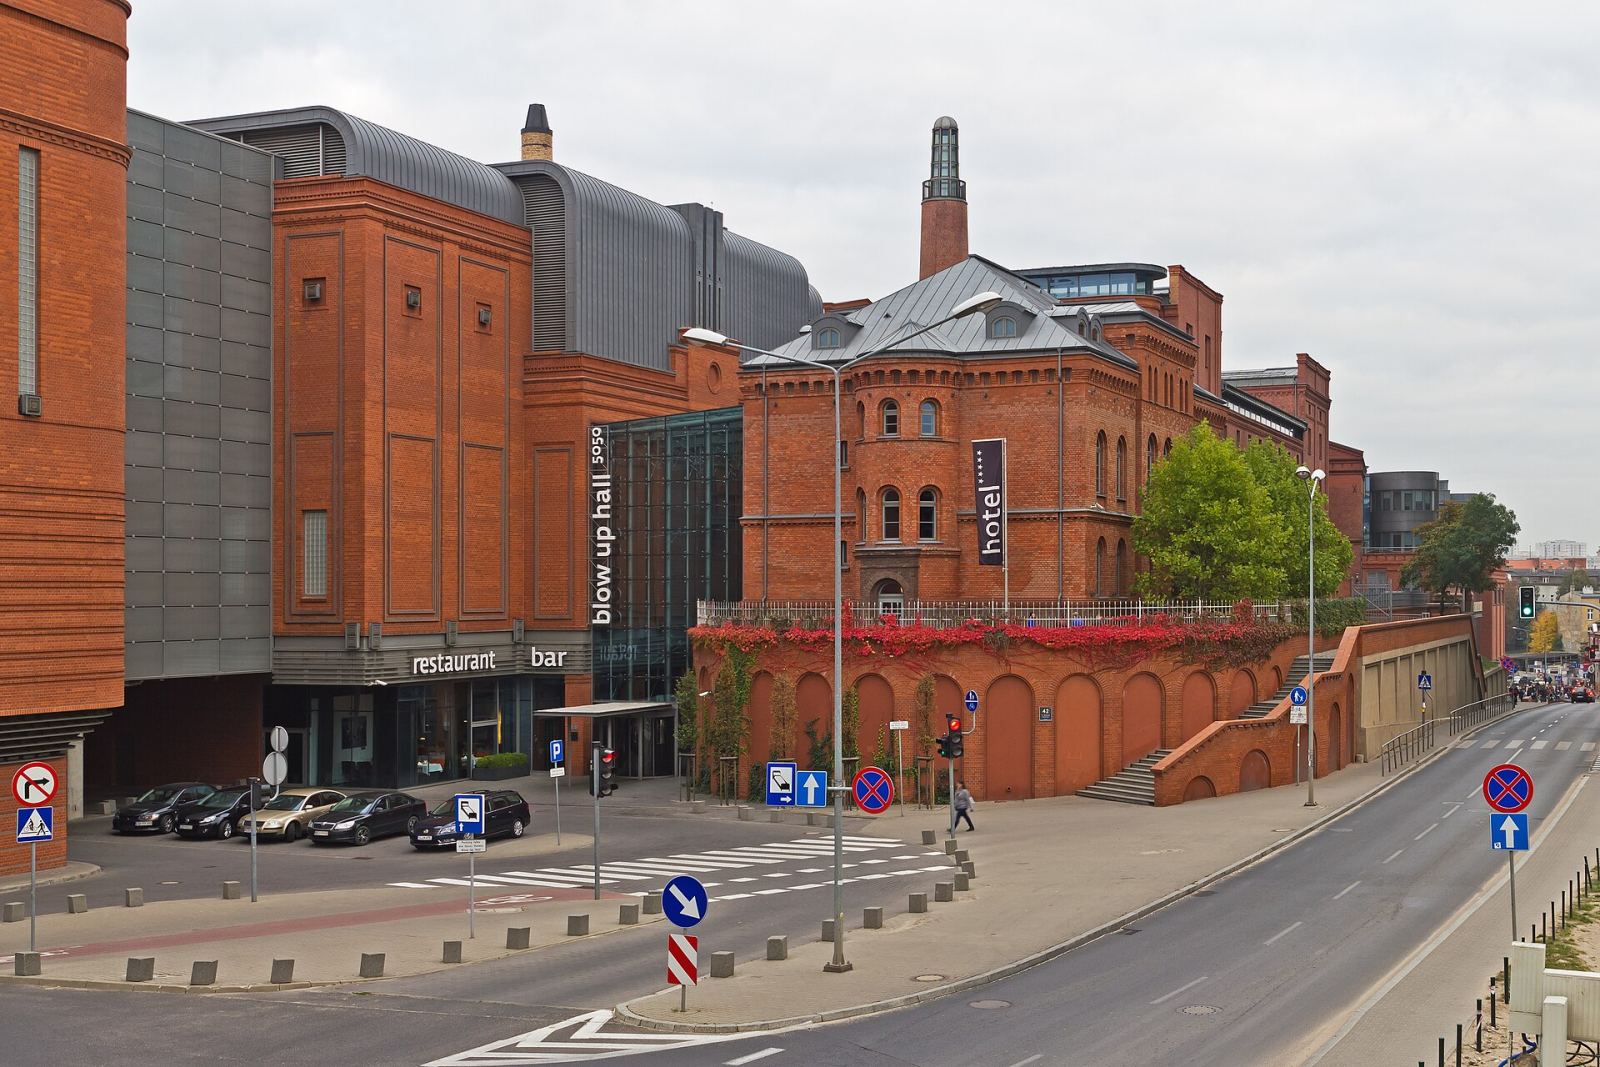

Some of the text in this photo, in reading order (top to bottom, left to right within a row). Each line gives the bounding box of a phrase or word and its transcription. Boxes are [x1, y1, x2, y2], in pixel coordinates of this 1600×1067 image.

[592, 427, 616, 624] blow up hall 5050
[978, 485, 1001, 554] hotel
[413, 650, 496, 674] restaurant
[531, 646, 567, 667] bar
[553, 743, 561, 760] P
